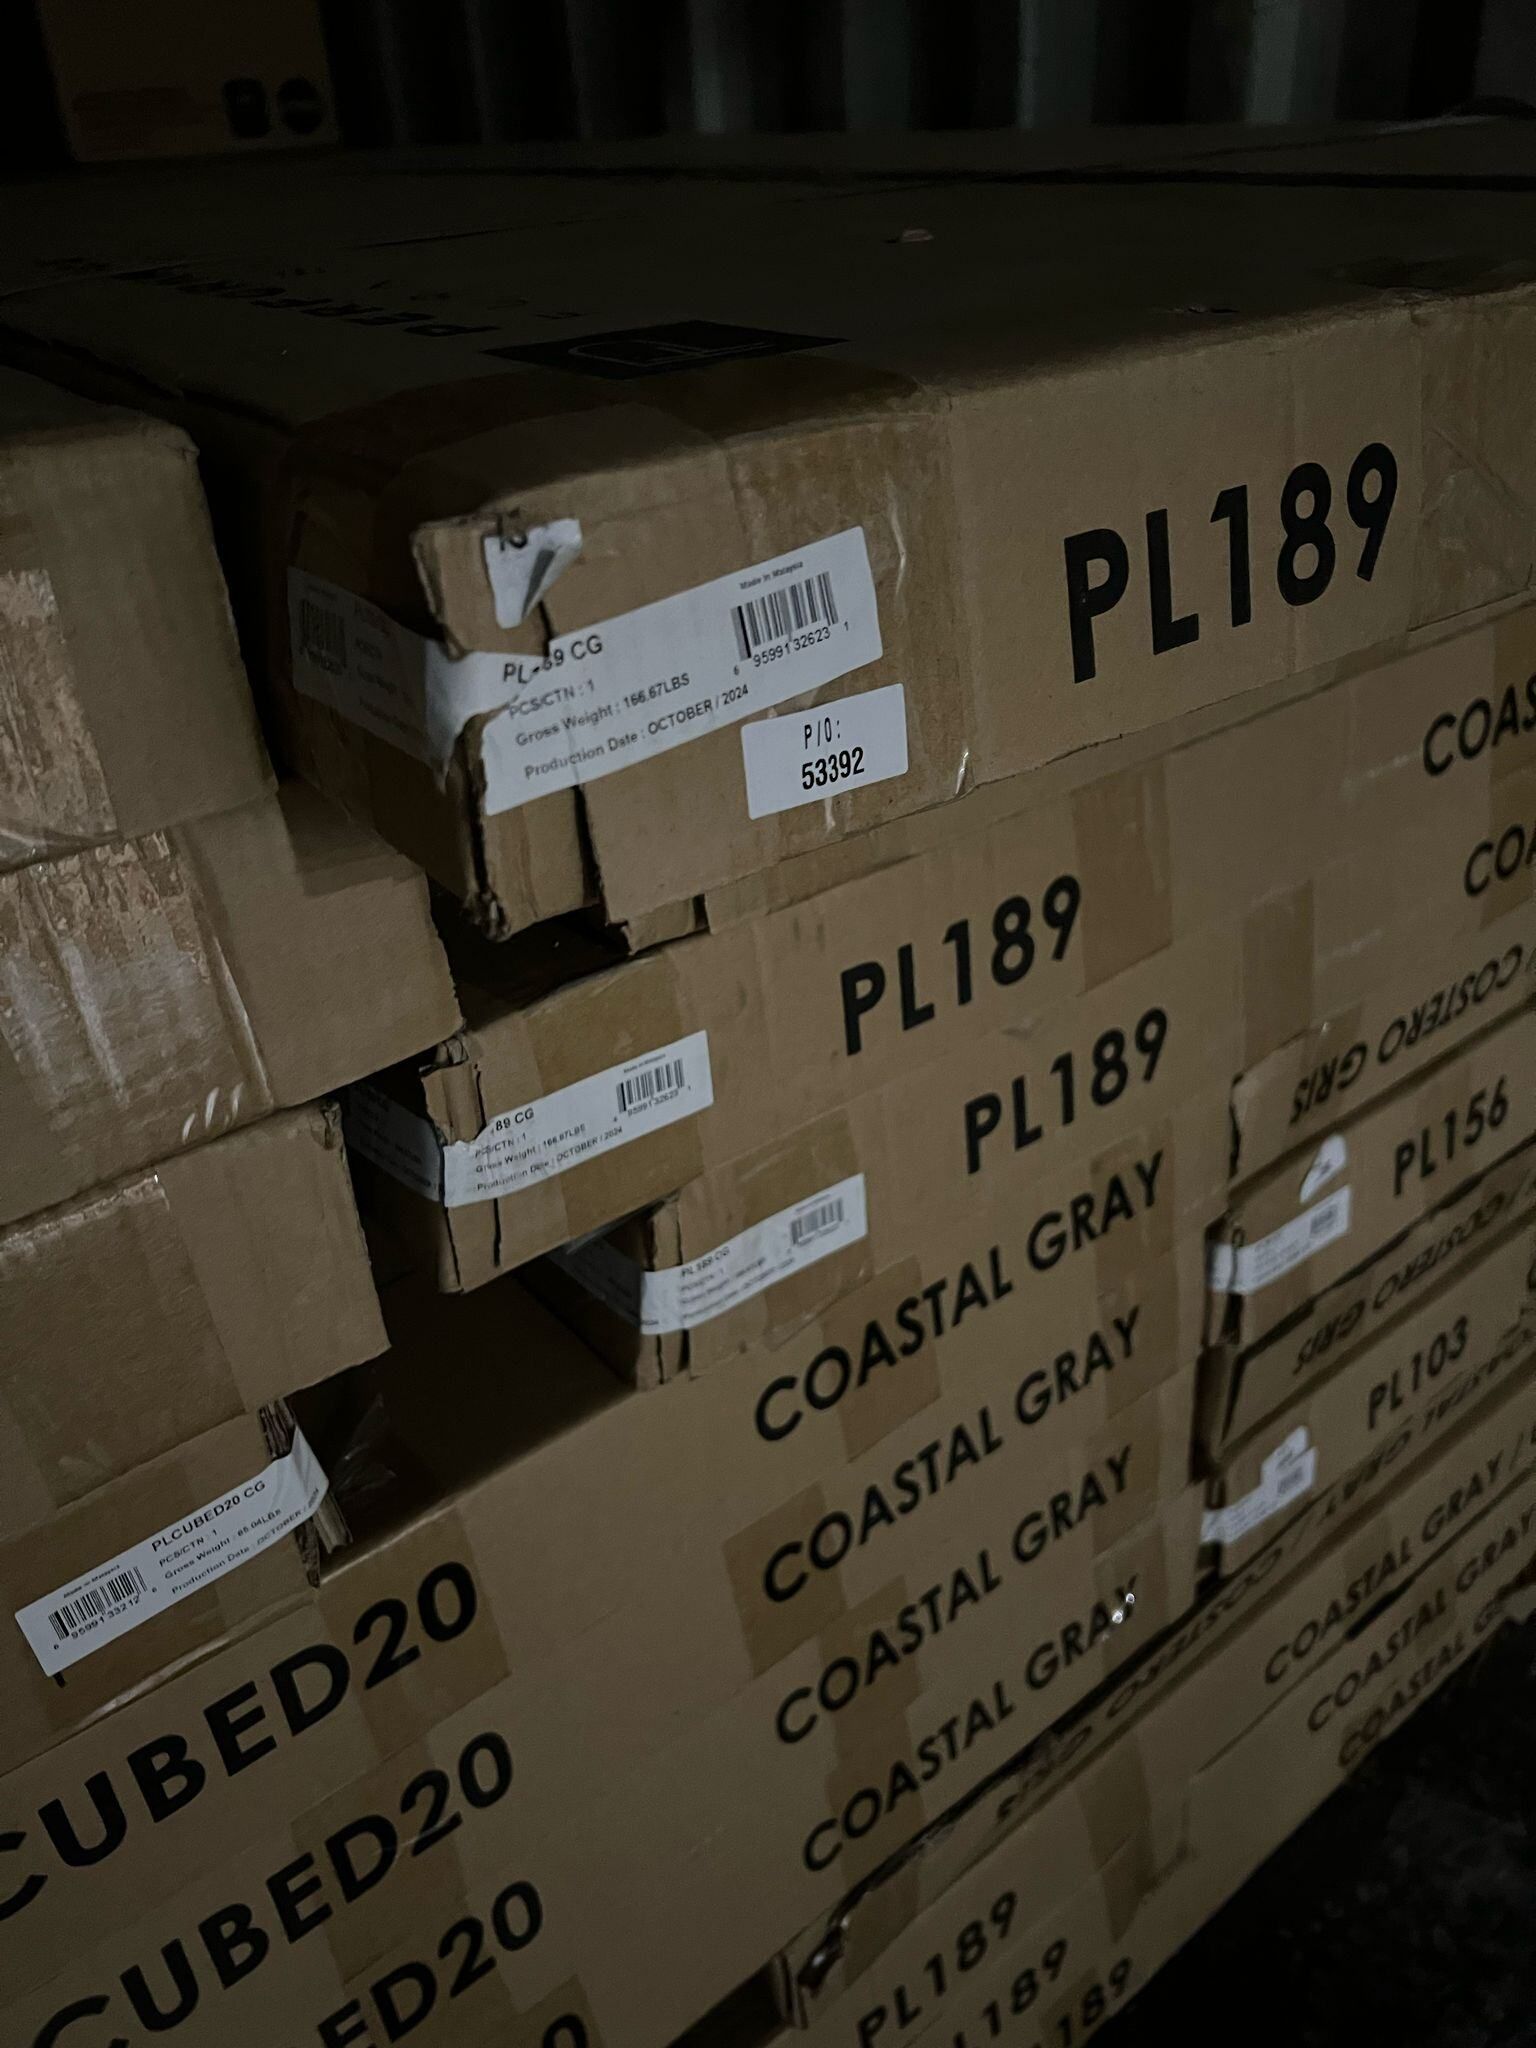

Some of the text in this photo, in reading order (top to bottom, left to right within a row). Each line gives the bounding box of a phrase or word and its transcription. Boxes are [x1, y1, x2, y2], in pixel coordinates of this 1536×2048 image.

[1064, 443, 1398, 684] PL189
[571, 634, 603, 660] CG
[516, 724, 560, 747] Gross
[563, 705, 614, 731] Weight
[525, 745, 605, 780] Production
[608, 731, 638, 752] Date
[648, 698, 713, 735] OCTOBER
[722, 684, 749, 705] 2024
[802, 747, 865, 790] 53392
[841, 875, 1081, 1056] PL189
[964, 1007, 1167, 1174] PL189
[1394, 1074, 1508, 1196] PL156
[755, 1149, 1163, 1441] COASTAL GRAY
[1369, 1315, 1468, 1428] PL103
[151, 1480, 266, 1552] PLCUBED20 CG
[763, 1305, 1140, 1603] COASTAL GRAY
[171, 1559, 226, 1595] Production
[776, 1446, 1131, 1744] COASTAL GRAY
[1264, 1536, 1412, 1686] COASTAL
[804, 1574, 1138, 1872] COASTAL GRAY
[1307, 1588, 1447, 1732] COASTAL
